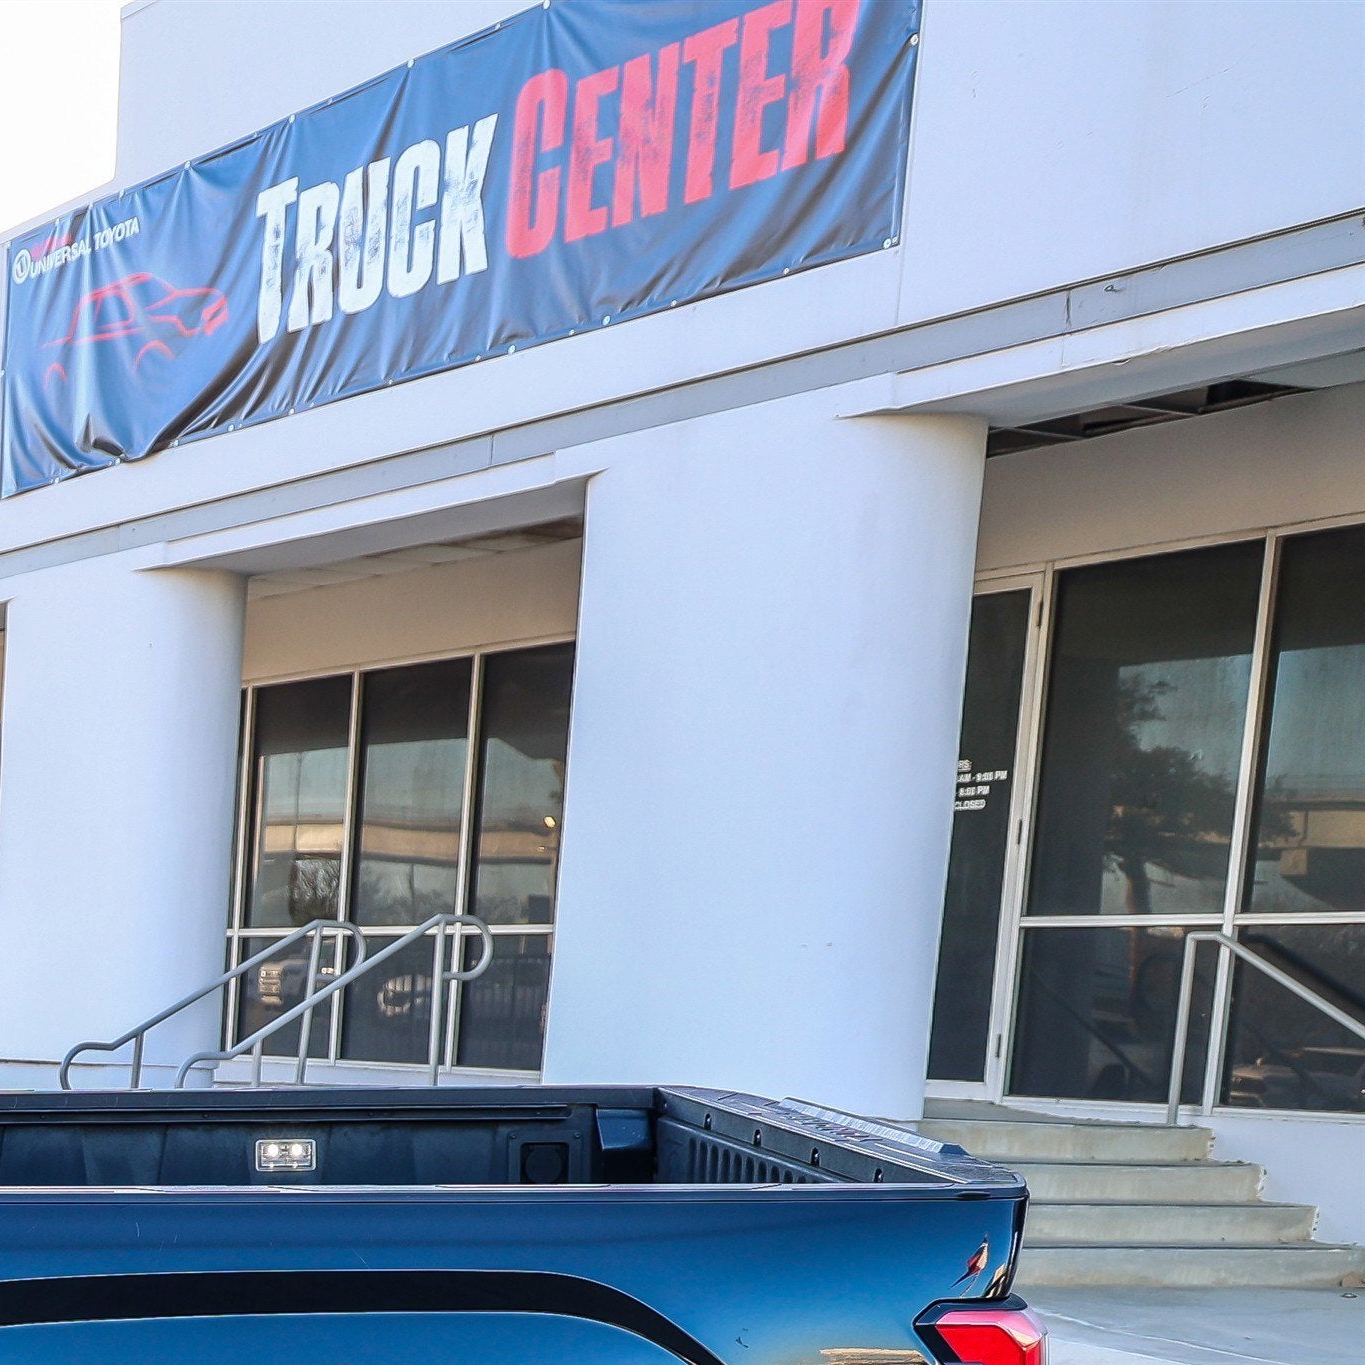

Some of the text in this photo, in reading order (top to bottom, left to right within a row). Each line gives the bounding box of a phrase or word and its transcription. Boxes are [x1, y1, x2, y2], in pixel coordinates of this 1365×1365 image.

[30, 239, 92, 278] UNIVERSAL
[93, 216, 140, 250] TOYOTA
[256, 0, 861, 344] TRUCK CENTER
